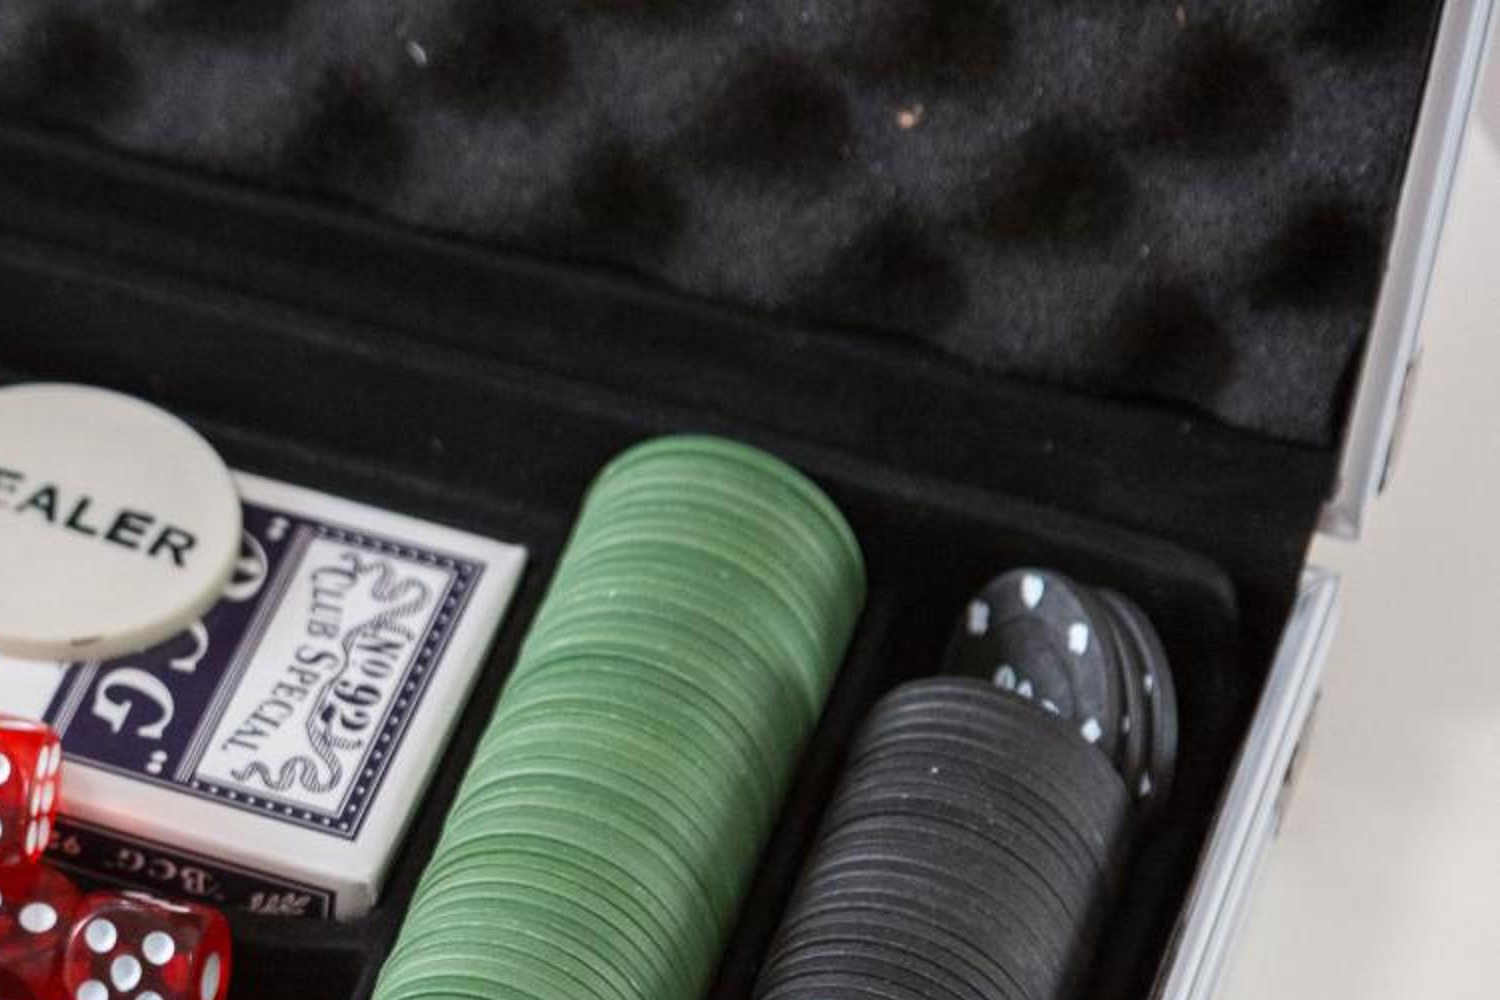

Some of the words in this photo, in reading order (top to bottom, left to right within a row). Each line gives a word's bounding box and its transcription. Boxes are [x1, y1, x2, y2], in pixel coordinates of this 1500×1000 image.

[306, 562, 361, 641] CLUB
[221, 643, 342, 752] SPECIAL
[319, 680, 383, 731] 92
